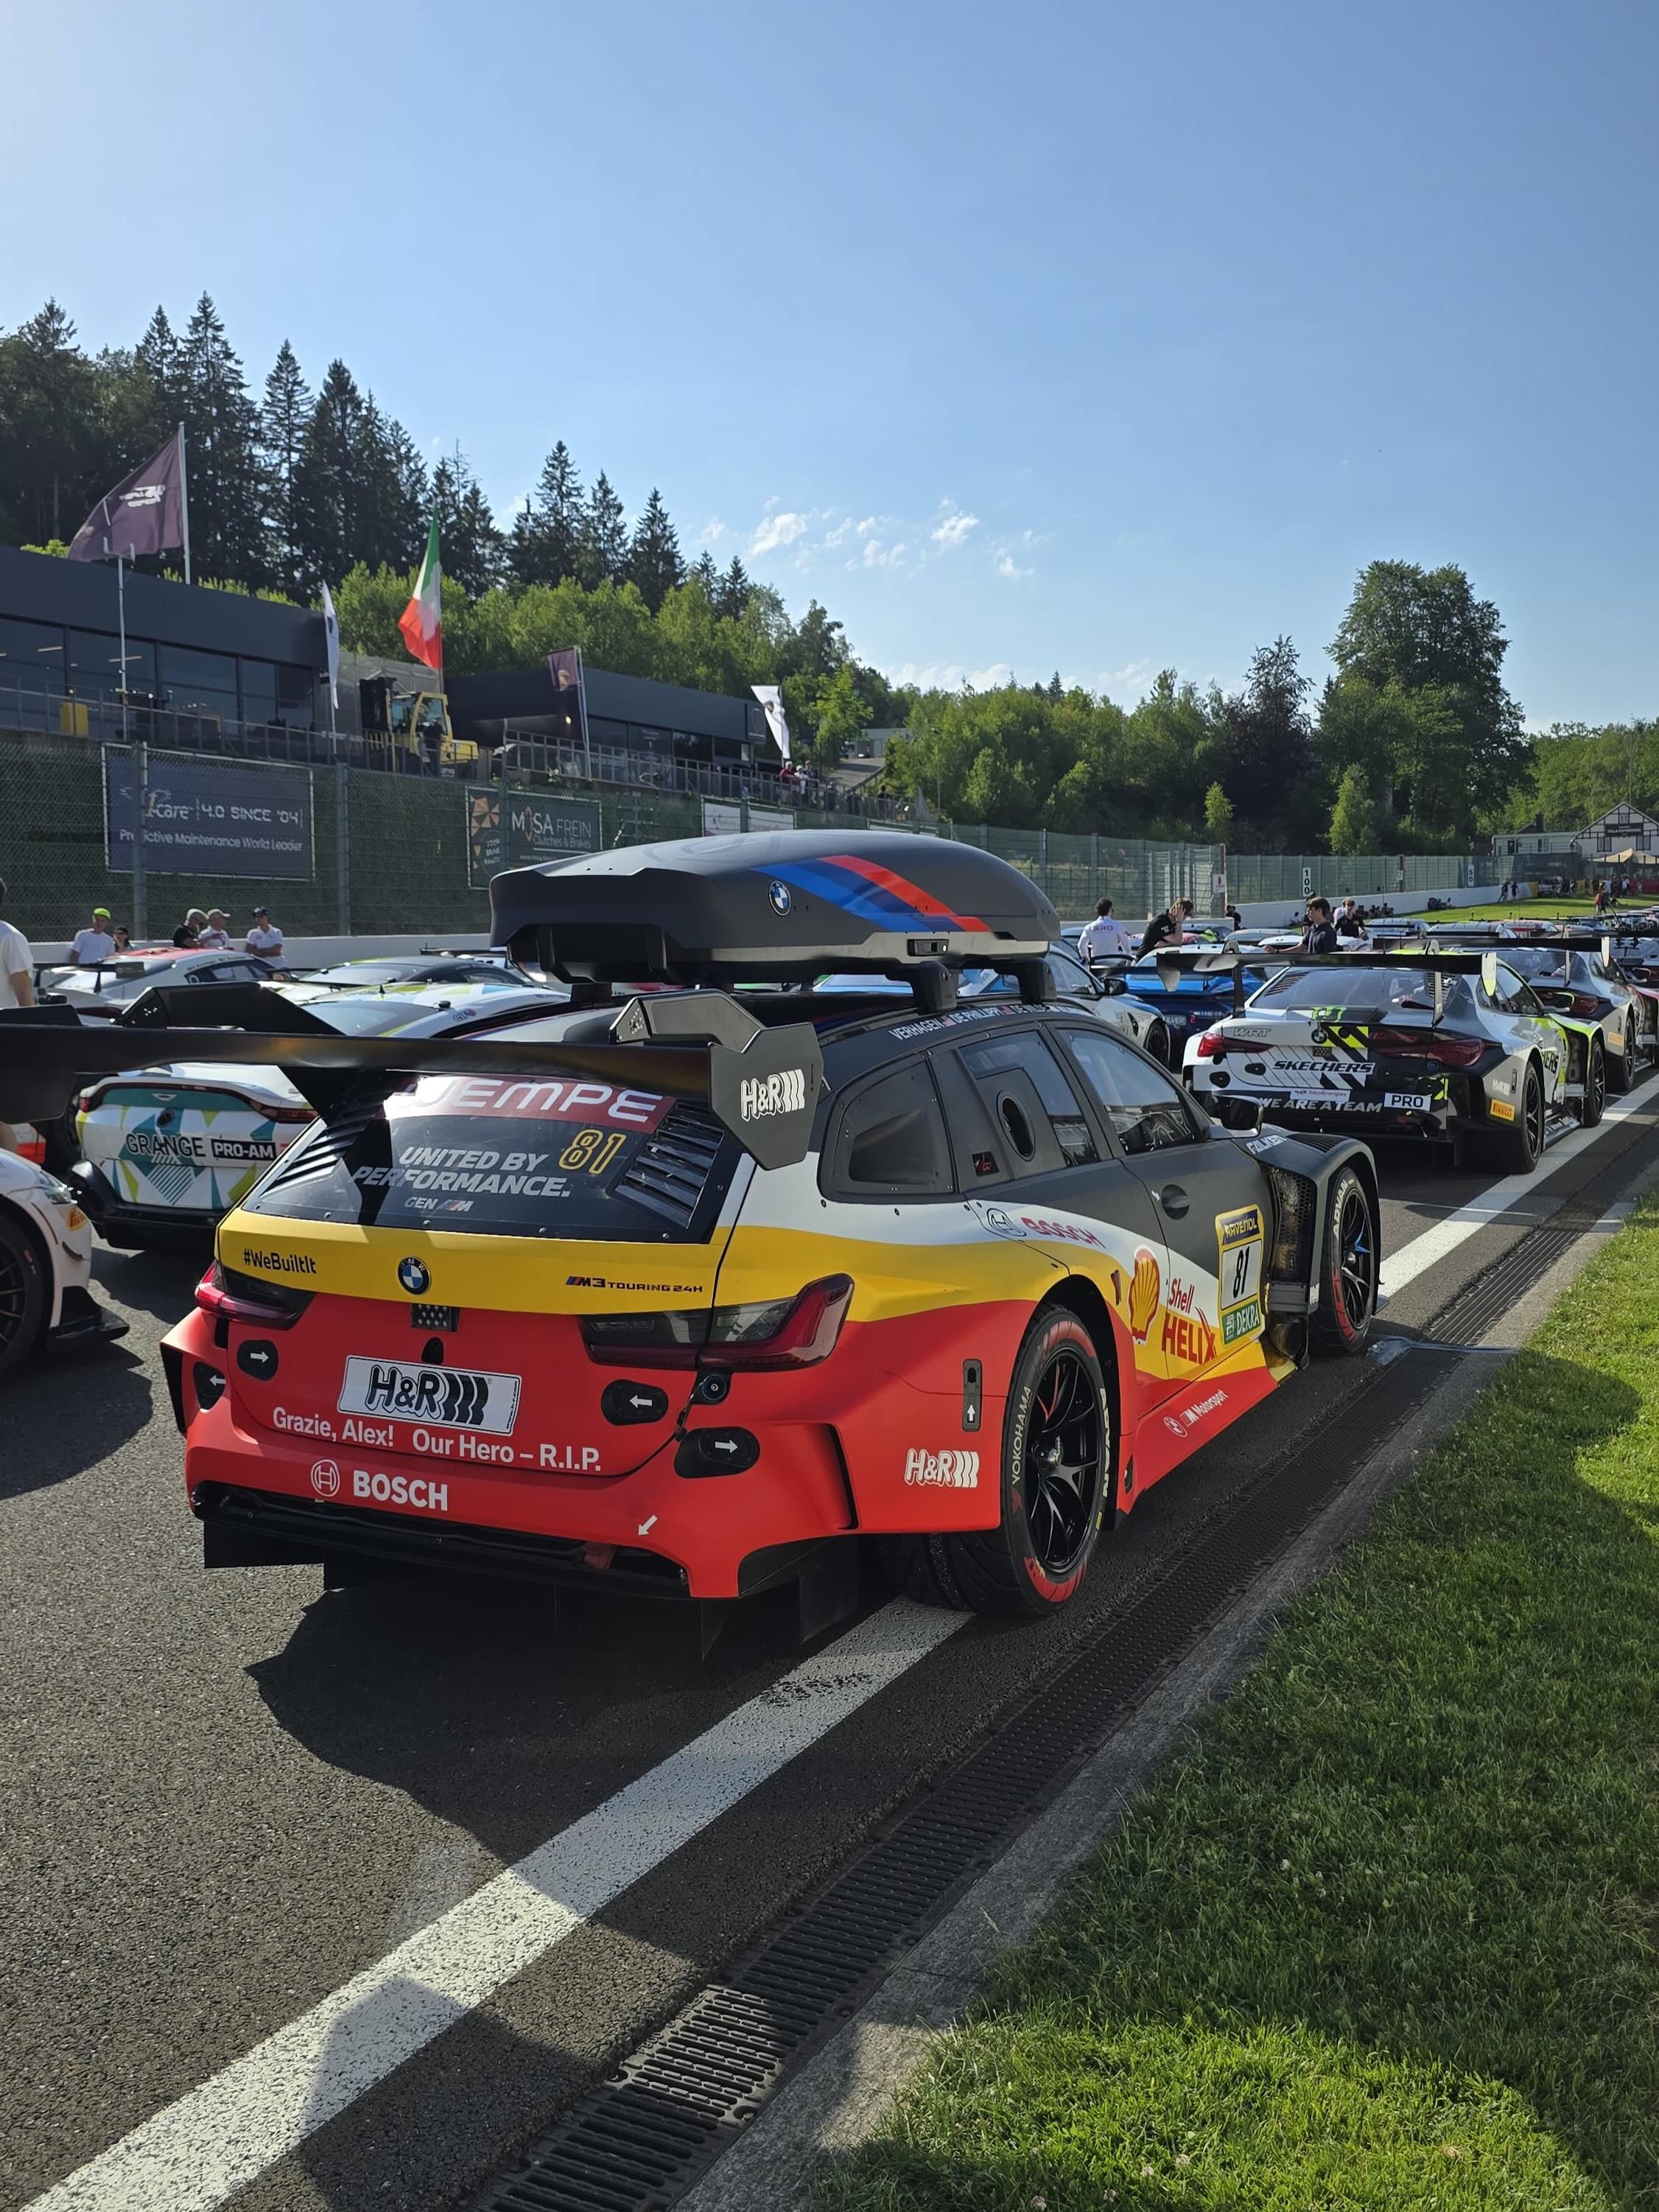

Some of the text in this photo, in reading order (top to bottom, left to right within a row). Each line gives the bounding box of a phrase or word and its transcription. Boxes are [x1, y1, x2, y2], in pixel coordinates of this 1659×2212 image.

[231, 807, 272, 822] SINCE
[175, 833, 241, 847] Maintenance
[242, 837, 270, 849] World
[271, 840, 303, 851] Leader
[889, 1018, 945, 1040] VERHAGEN
[1273, 1060, 1375, 1074] SKECHERS
[741, 1074, 785, 1121] H&R
[1260, 1097, 1383, 1113] WE ARE A TEAM
[1391, 1095, 1424, 1108] PRO
[125, 1133, 275, 1158] GRANGE PRO-AM
[399, 1147, 550, 1172] UNITED BY
[558, 1129, 627, 1175] 81
[351, 1166, 571, 1197] PERFORMANCE.
[404, 1196, 438, 1210] GEN
[1333, 1179, 1348, 1239] ADVAN
[1020, 1217, 1107, 1250] BOSCH
[1224, 1217, 1258, 1239] RAVENOL
[243, 1248, 318, 1275] #WeBuiltIt
[1233, 1245, 1250, 1299] 81
[607, 1281, 671, 1292] TOURING
[1168, 1278, 1196, 1314] Shell
[1236, 1302, 1260, 1336] DEKRA
[1161, 1307, 1217, 1365] HELIX
[365, 1364, 448, 1421] H&R
[1190, 1388, 1229, 1418] Motorsport
[272, 1406, 337, 1443] Grazie,
[341, 1418, 394, 1447] Alex!
[412, 1428, 455, 1456] Our
[458, 1434, 514, 1463] Hero
[539, 1442, 602, 1472] R.I.P.
[1011, 1385, 1032, 1486] YOKOHAMA
[904, 1448, 956, 1487] H&R
[353, 1469, 449, 1511] BOSCH
